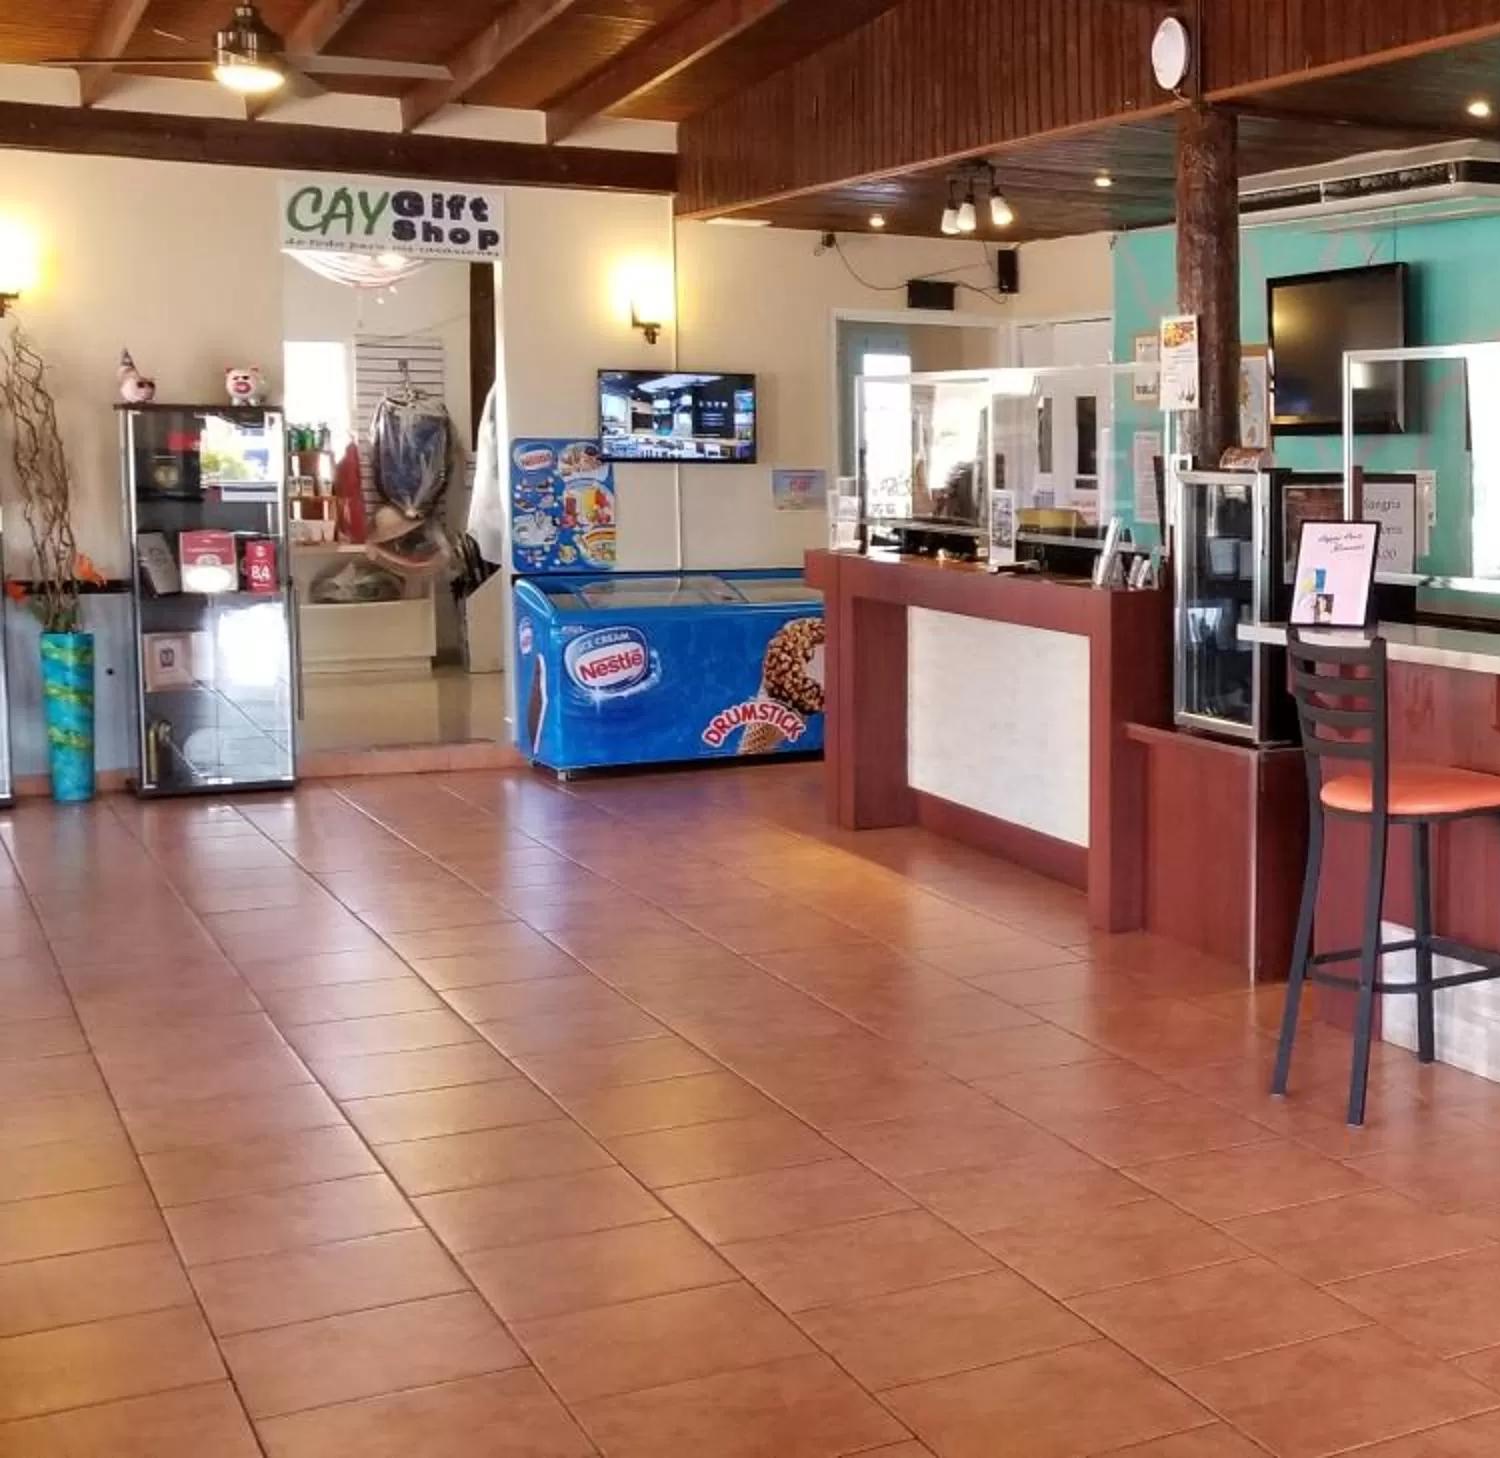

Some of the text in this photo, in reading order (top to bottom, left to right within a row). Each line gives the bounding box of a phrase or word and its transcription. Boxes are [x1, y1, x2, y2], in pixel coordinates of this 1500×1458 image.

[286, 186, 390, 236] CAY
[391, 190, 489, 222] Gift
[391, 219, 500, 250] Shop
[595, 631, 630, 645] CREAM
[704, 702, 804, 744] DRUMSTICK
